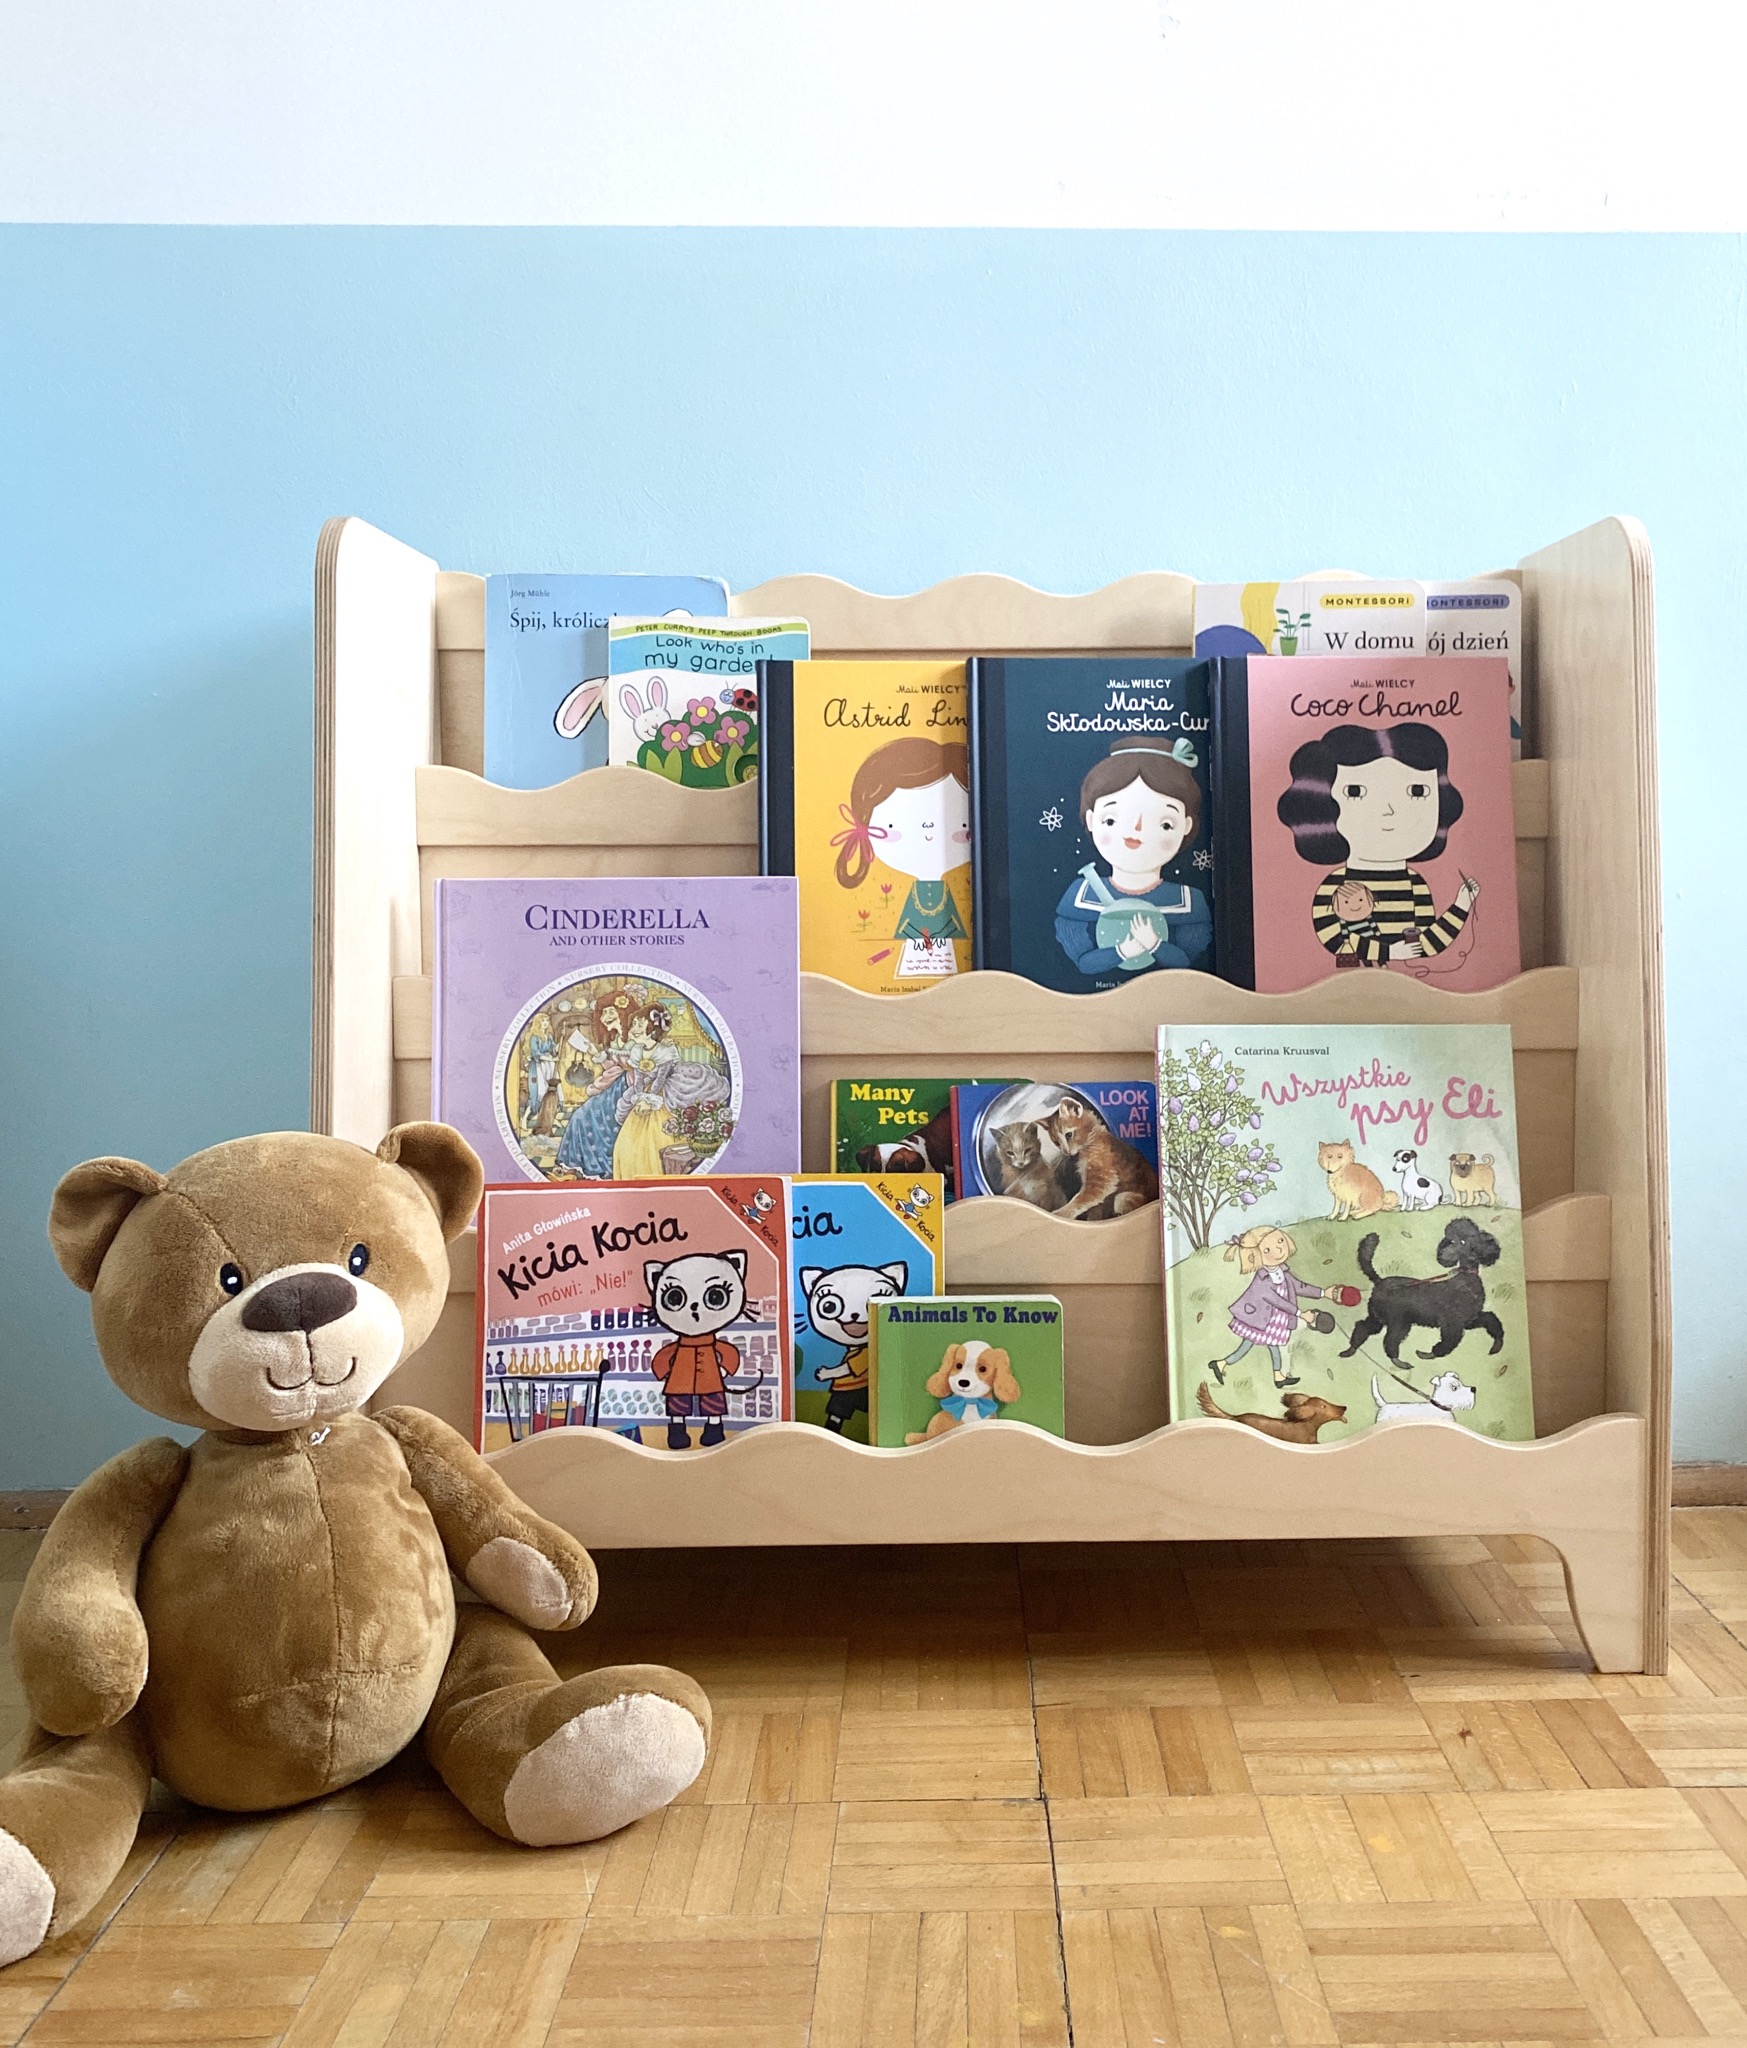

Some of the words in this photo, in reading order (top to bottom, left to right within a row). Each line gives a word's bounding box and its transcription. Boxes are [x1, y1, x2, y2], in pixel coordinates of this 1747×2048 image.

[510, 590, 526, 598] Jörg
[1325, 597, 1410, 606] MONTESSORI
[510, 607, 546, 632] Śpij,
[553, 611, 617, 629] królicz
[635, 624, 658, 632] PETER
[663, 624, 694, 633] CURRY'S
[698, 628, 717, 636] PEEP
[756, 626, 782, 635] BOOKS
[656, 635, 693, 648] Look
[701, 641, 744, 655] who's
[751, 642, 764, 654] in
[1324, 632, 1349, 650] W
[1355, 631, 1414, 650] domu
[1427, 632, 1446, 656] ój
[1452, 630, 1509, 651] dzień
[645, 652, 678, 669] my
[921, 685, 960, 694] WIELCY
[1106, 679, 1130, 689] Mali
[1131, 679, 1172, 689] WIELCY
[1375, 679, 1415, 688] WIELCY
[1104, 691, 1174, 711] Maria
[1290, 692, 1353, 718] Coco
[1359, 691, 1463, 718] Chanel
[823, 698, 911, 728] Astrid
[524, 904, 710, 930] CINDERELLA
[549, 935, 577, 946] AND
[580, 935, 627, 946] OTHER
[629, 935, 685, 946] STORIES
[564, 965, 606, 982] NURSERY
[610, 964, 674, 982] COLLECTION
[1234, 1046, 1280, 1056] Catarina
[1283, 1046, 1330, 1056] Kruusval
[850, 1083, 915, 1104] Many
[1261, 1058, 1411, 1109] Wszystkie
[1100, 1089, 1148, 1106] LOOK
[878, 1107, 930, 1125] Pets
[1128, 1106, 1149, 1122] AT
[1350, 1097, 1434, 1146] psy
[1441, 1076, 1503, 1119] Eli
[1119, 1122, 1152, 1138] ME!
[720, 1186, 739, 1206] Kicia
[875, 1181, 895, 1203] Kicia
[502, 1230, 533, 1254] Anita
[533, 1206, 592, 1237] Głowińska
[760, 1224, 780, 1247] Kocia
[915, 1219, 936, 1242] Kocia
[497, 1241, 589, 1300] Kicia
[591, 1211, 688, 1258] Kocia
[538, 1280, 584, 1307] mówi:
[887, 1306, 968, 1324] Animals
[972, 1306, 997, 1324] To
[1003, 1306, 1059, 1324] Know
